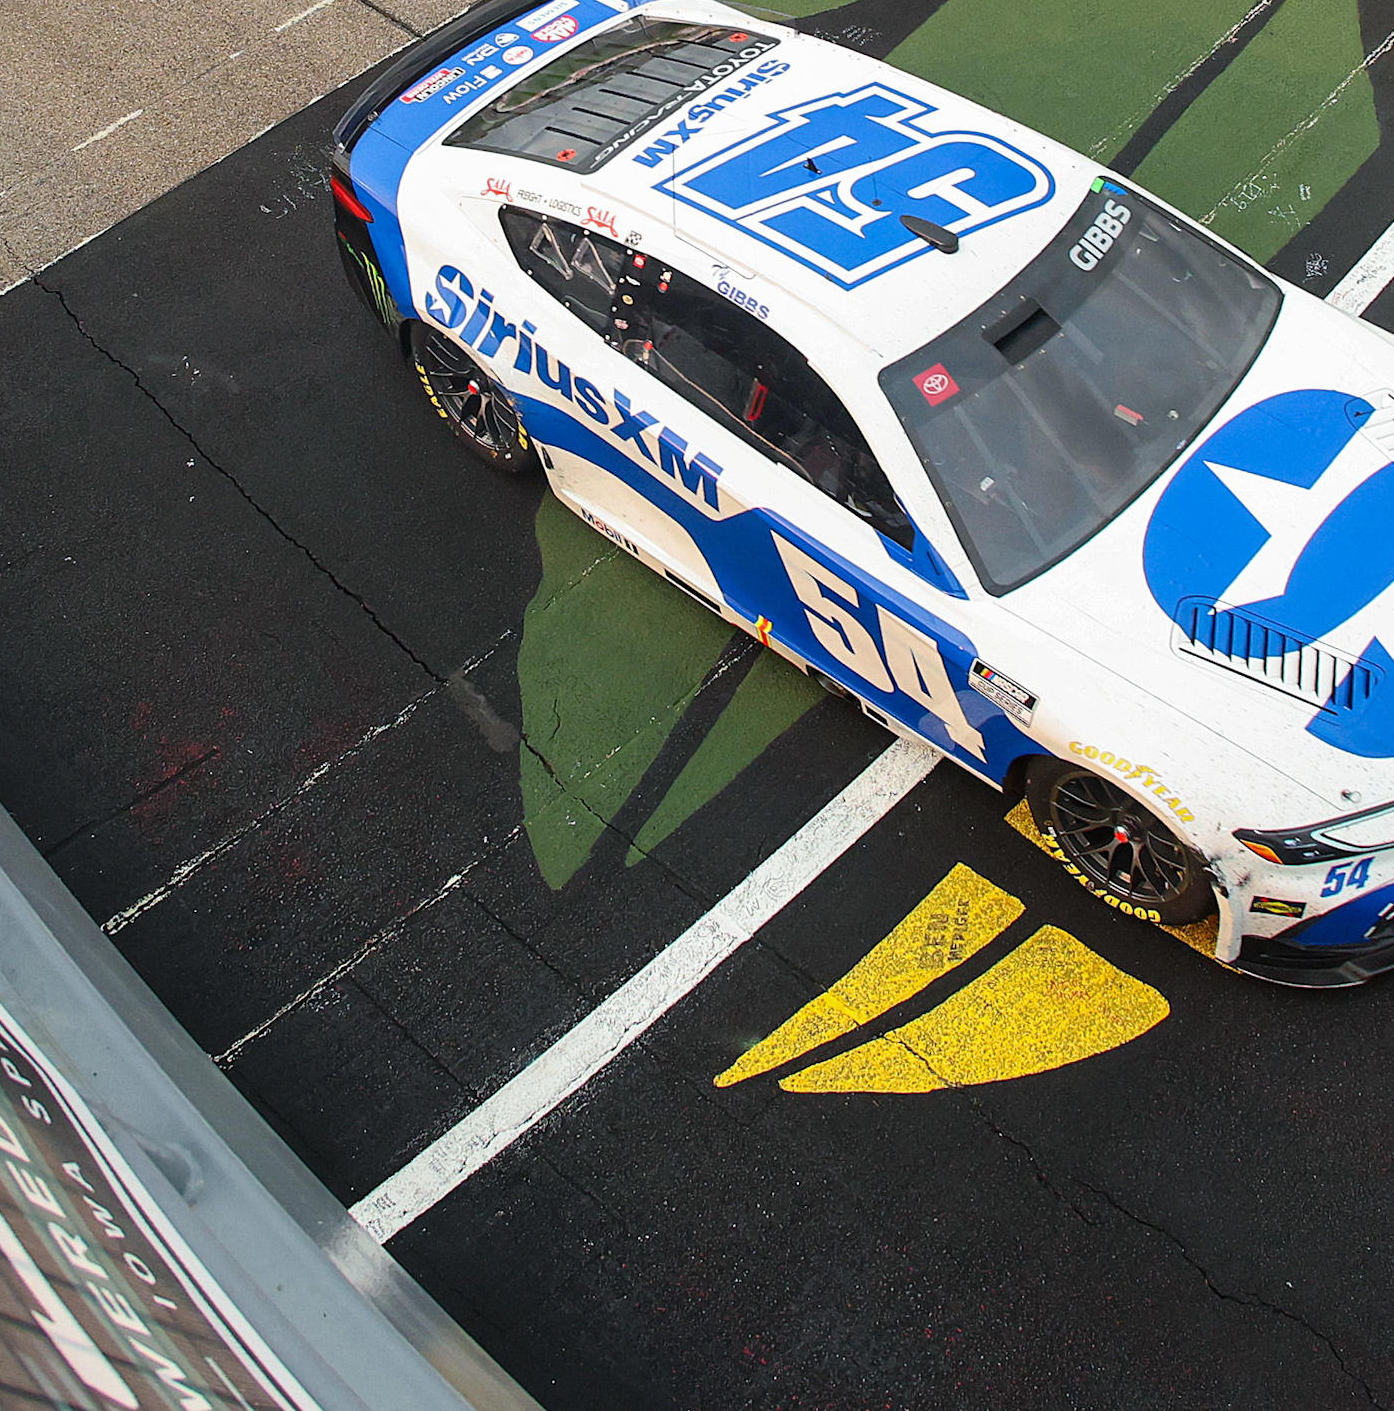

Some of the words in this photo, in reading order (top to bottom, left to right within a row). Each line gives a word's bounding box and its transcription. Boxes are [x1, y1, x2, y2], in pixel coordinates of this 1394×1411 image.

[416, 68, 464, 102] LINCOLN
[442, 76, 488, 105] Flow
[684, 39, 774, 100] TOYOTA
[592, 97, 682, 164] RACING
[631, 58, 792, 169] SiriusXM
[480, 177, 514, 203] SAIA
[547, 196, 583, 217] LOGISTICS
[580, 205, 619, 238] SAIA
[652, 80, 1058, 293] 54
[1067, 197, 1133, 274] GIBBS
[716, 279, 771, 321] GIBBS
[424, 264, 724, 513] SiriusXM
[768, 528, 989, 764] 54
[1068, 740, 1196, 825] GOODYEAR
[1041, 832, 1162, 924] GOODYEAR
[1320, 855, 1376, 898] 54
[62, 1161, 178, 1311] IOWA
